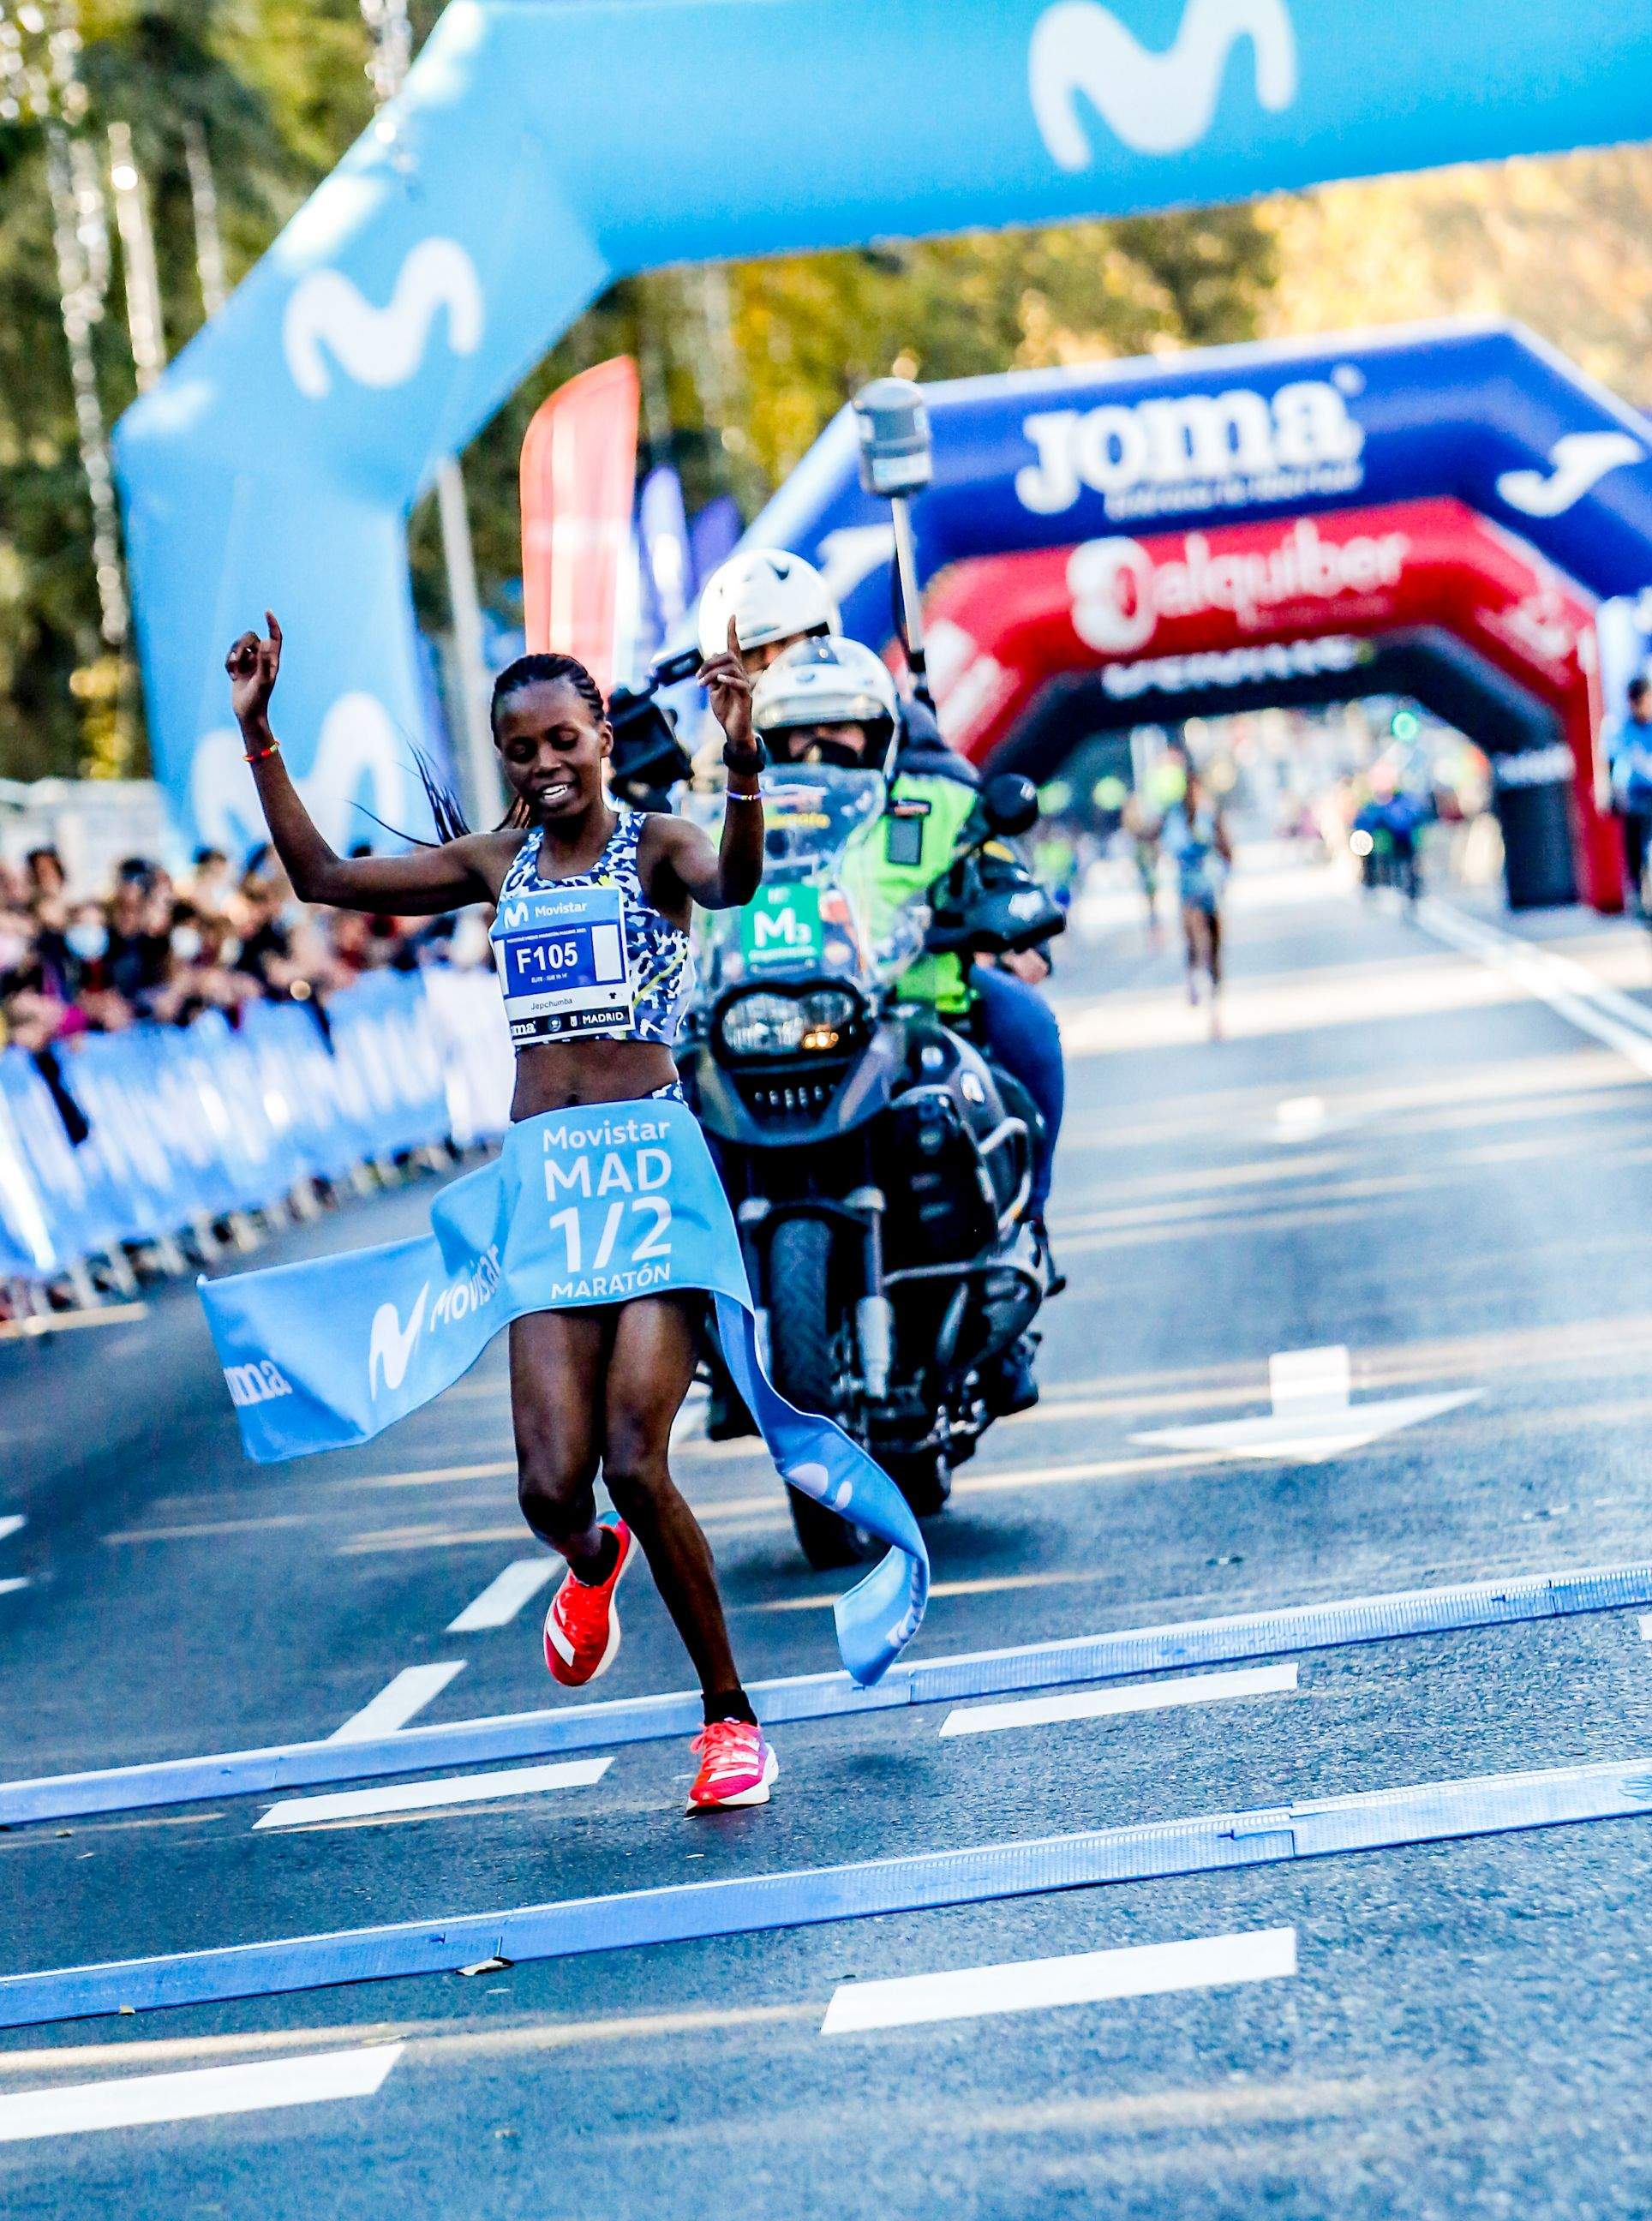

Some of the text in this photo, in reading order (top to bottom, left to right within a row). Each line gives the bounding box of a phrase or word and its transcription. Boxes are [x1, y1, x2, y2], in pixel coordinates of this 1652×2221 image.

[535, 901, 587, 918] Movistar
[516, 942, 578, 973] F105
[531, 997, 572, 1010] Jepchumba
[583, 1012, 624, 1025] MADRID
[511, 1022, 536, 1036] ma
[542, 1119, 671, 1152] Movistar
[544, 1148, 672, 1201] MAD
[549, 1196, 673, 1273] 1/2
[550, 1262, 671, 1300] MARATÓN
[223, 1360, 293, 1406] ma
